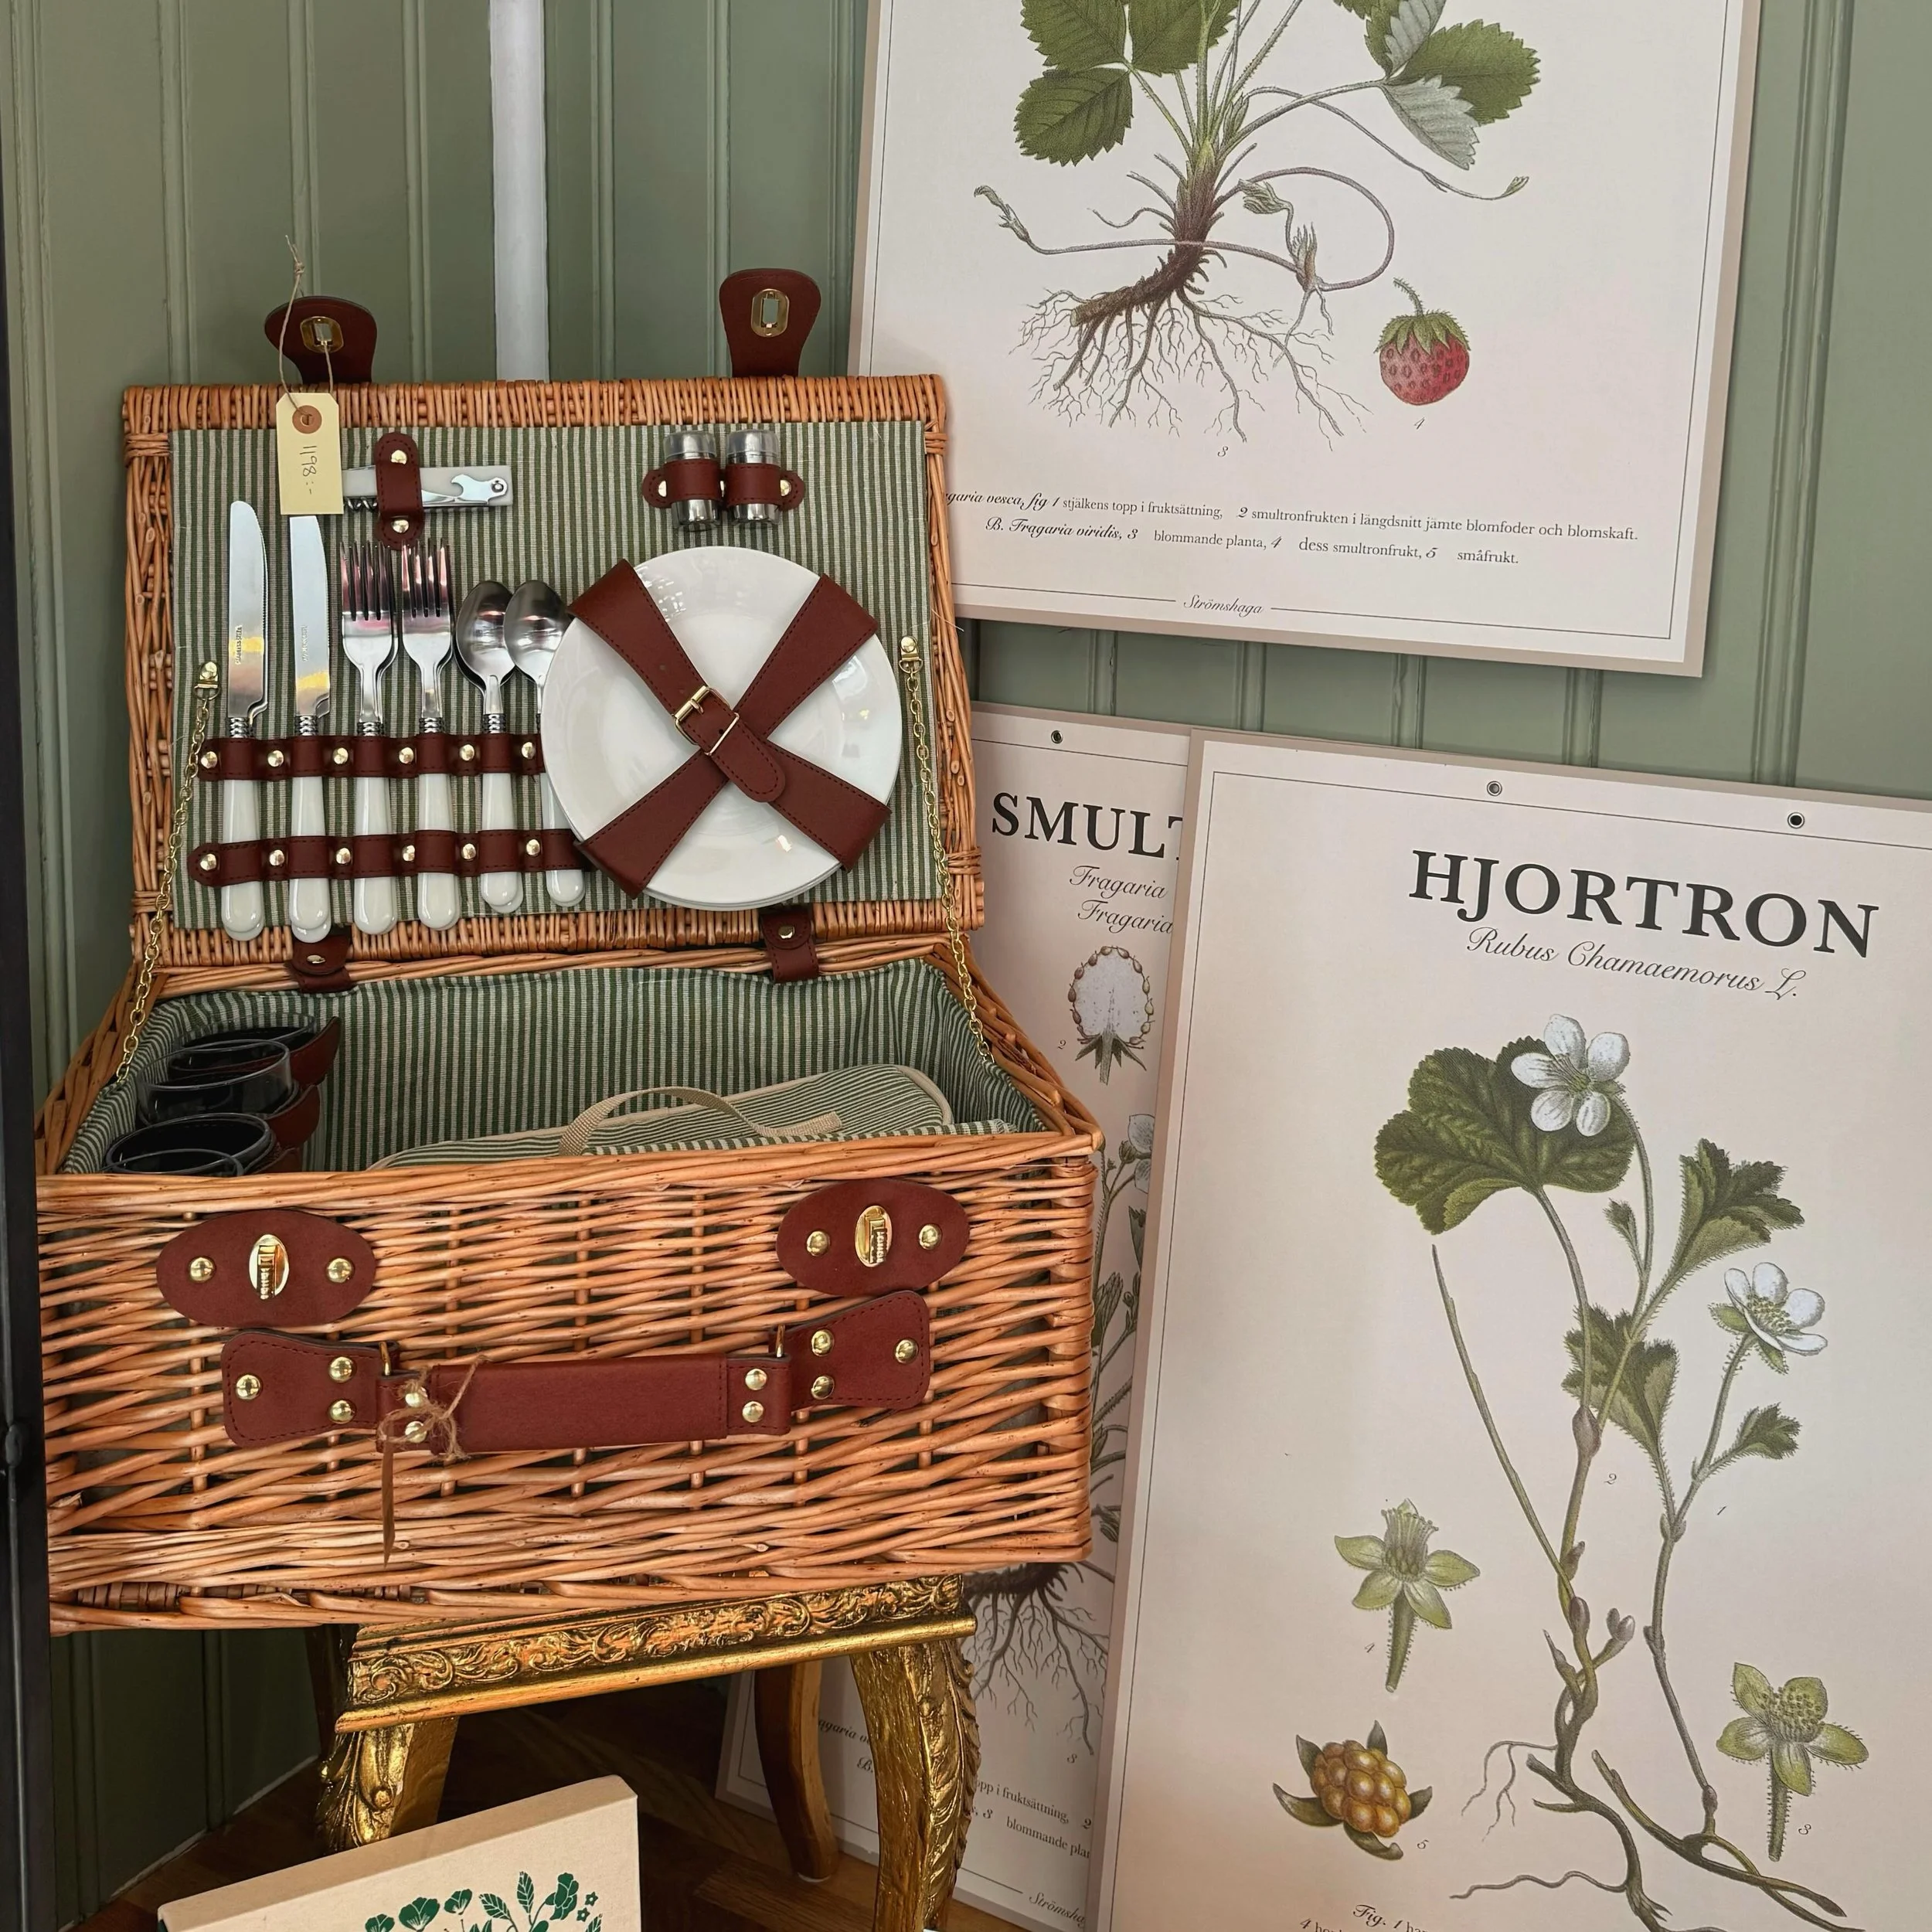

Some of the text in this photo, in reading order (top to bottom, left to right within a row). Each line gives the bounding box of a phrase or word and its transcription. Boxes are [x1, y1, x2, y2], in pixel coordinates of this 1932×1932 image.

[986, 495, 1025, 507] vesca,
[1019, 492, 1049, 511] fig
[1063, 497, 1109, 512] stjälkens
[1112, 501, 1138, 515] topp
[1140, 501, 1145, 512] i
[1148, 501, 1223, 520] fruktsättning,
[1236, 506, 1248, 519] 2
[1251, 509, 1349, 524] smultronfrukten
[1352, 512, 1356, 525] i
[1359, 513, 1422, 529] längdsnitt
[1423, 516, 1462, 532] jämte
[1466, 519, 1536, 535] blomfoder
[1538, 523, 1563, 536] och
[1567, 524, 1638, 540] blomskaft.
[985, 515, 1004, 531] B.
[1009, 518, 1074, 539] Fragaria
[1076, 524, 1122, 540] viridis,
[1127, 528, 1138, 539] 3
[1154, 529, 1223, 546] blommande
[1226, 534, 1267, 550] planta,
[1298, 536, 1329, 552] dess
[1332, 542, 1422, 560] smultronfrukt,
[1425, 546, 1438, 559] 5
[1457, 549, 1519, 564] småfrukt.
[1183, 594, 1264, 617] Strömshaga
[992, 792, 1182, 860] SMUL
[1069, 865, 1169, 899] Fragaria
[1077, 900, 1174, 934] Fragaria
[1408, 849, 1879, 958] HJORTRON
[1466, 927, 1807, 1001] Rubus Chamaemorus L.
[1604, 1473, 1617, 1485] 2
[996, 1784, 1001, 1796] i
[1002, 1787, 1069, 1824] fruktsättning,
[1082, 1818, 1092, 1829] 2
[1006, 1816, 1068, 1850] blommande
[1798, 1824, 1811, 1835] 3
[1352, 1904, 1387, 1927] Fig.
